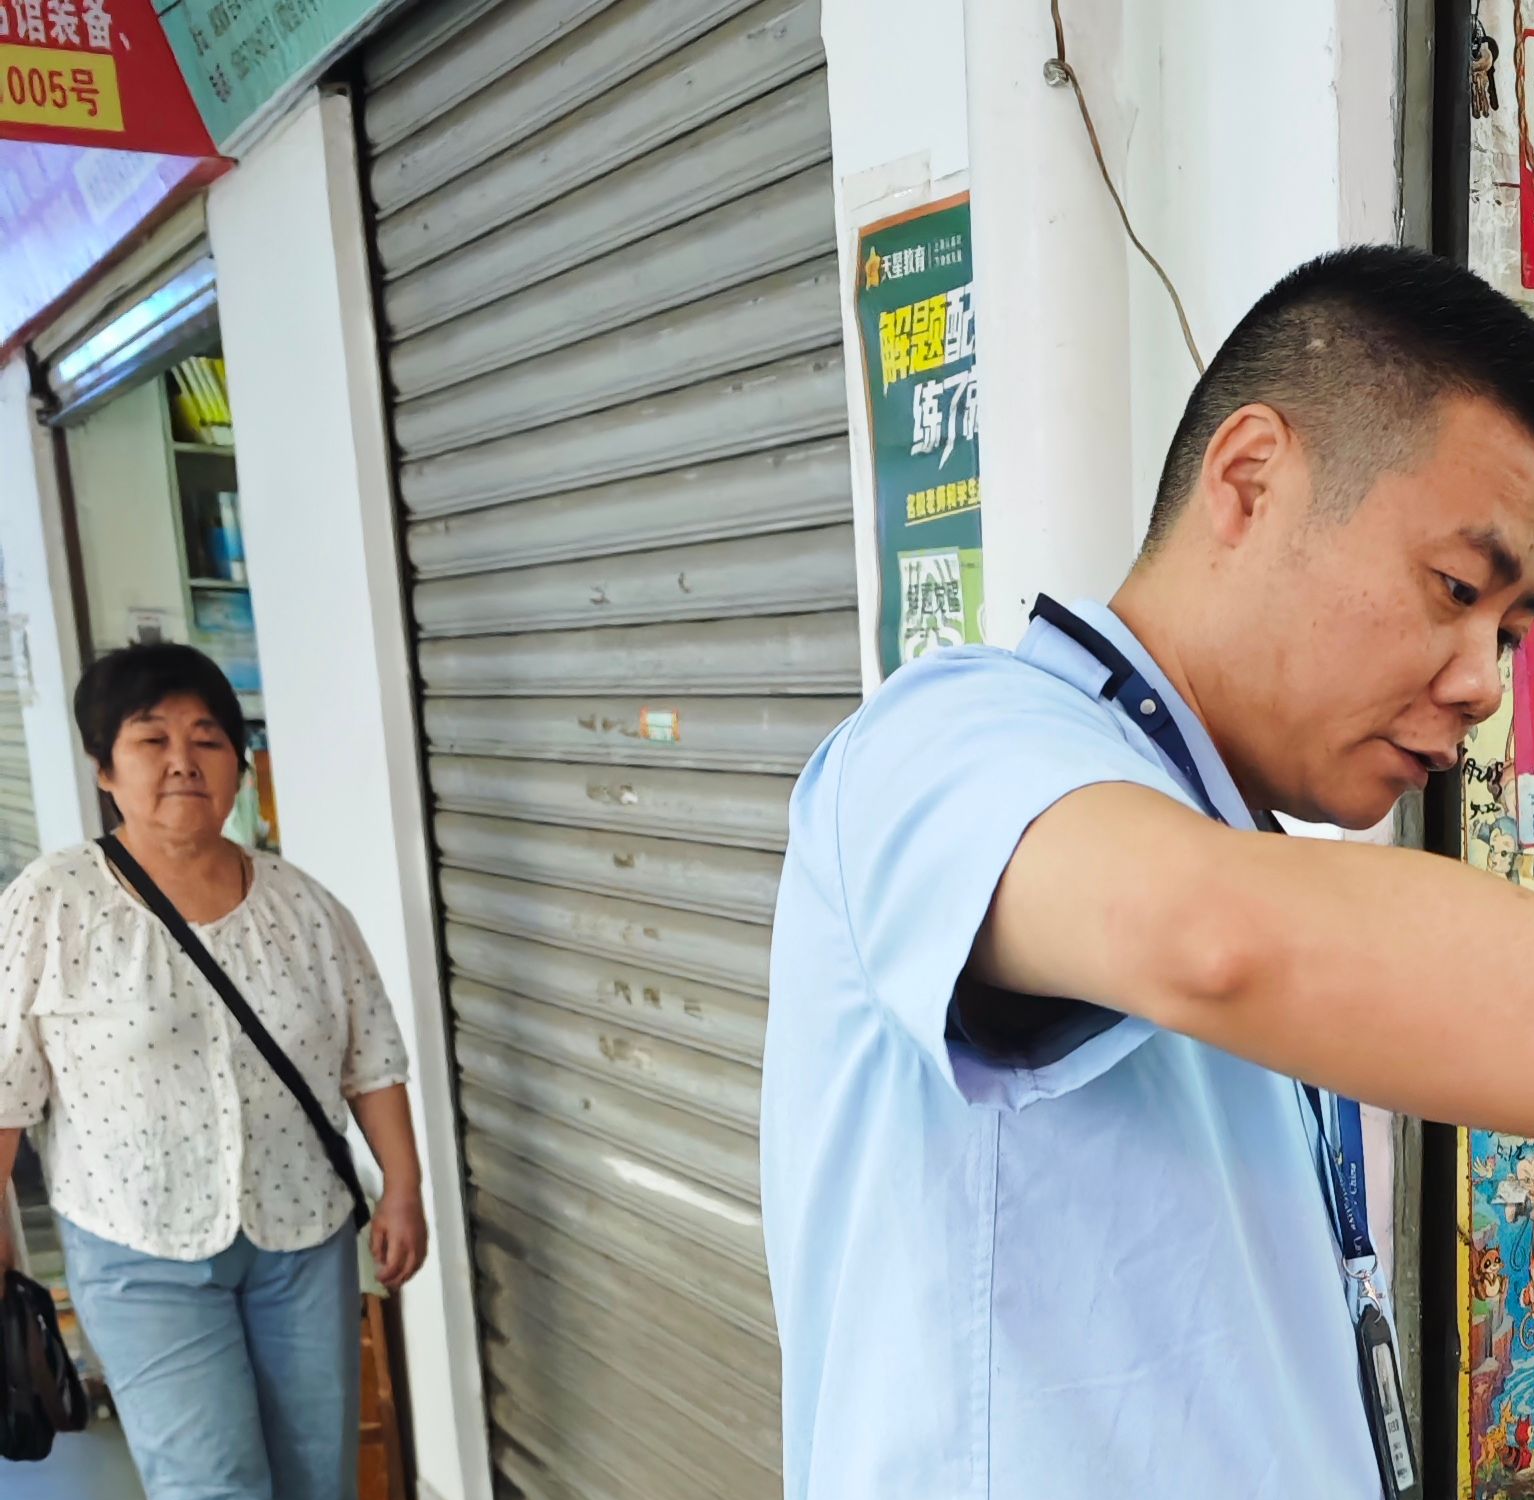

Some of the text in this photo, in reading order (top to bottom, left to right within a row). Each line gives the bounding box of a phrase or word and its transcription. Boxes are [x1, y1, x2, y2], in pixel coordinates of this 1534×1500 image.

[0, 66, 99, 116] 005号
[881, 245, 926, 282] 天星教育
